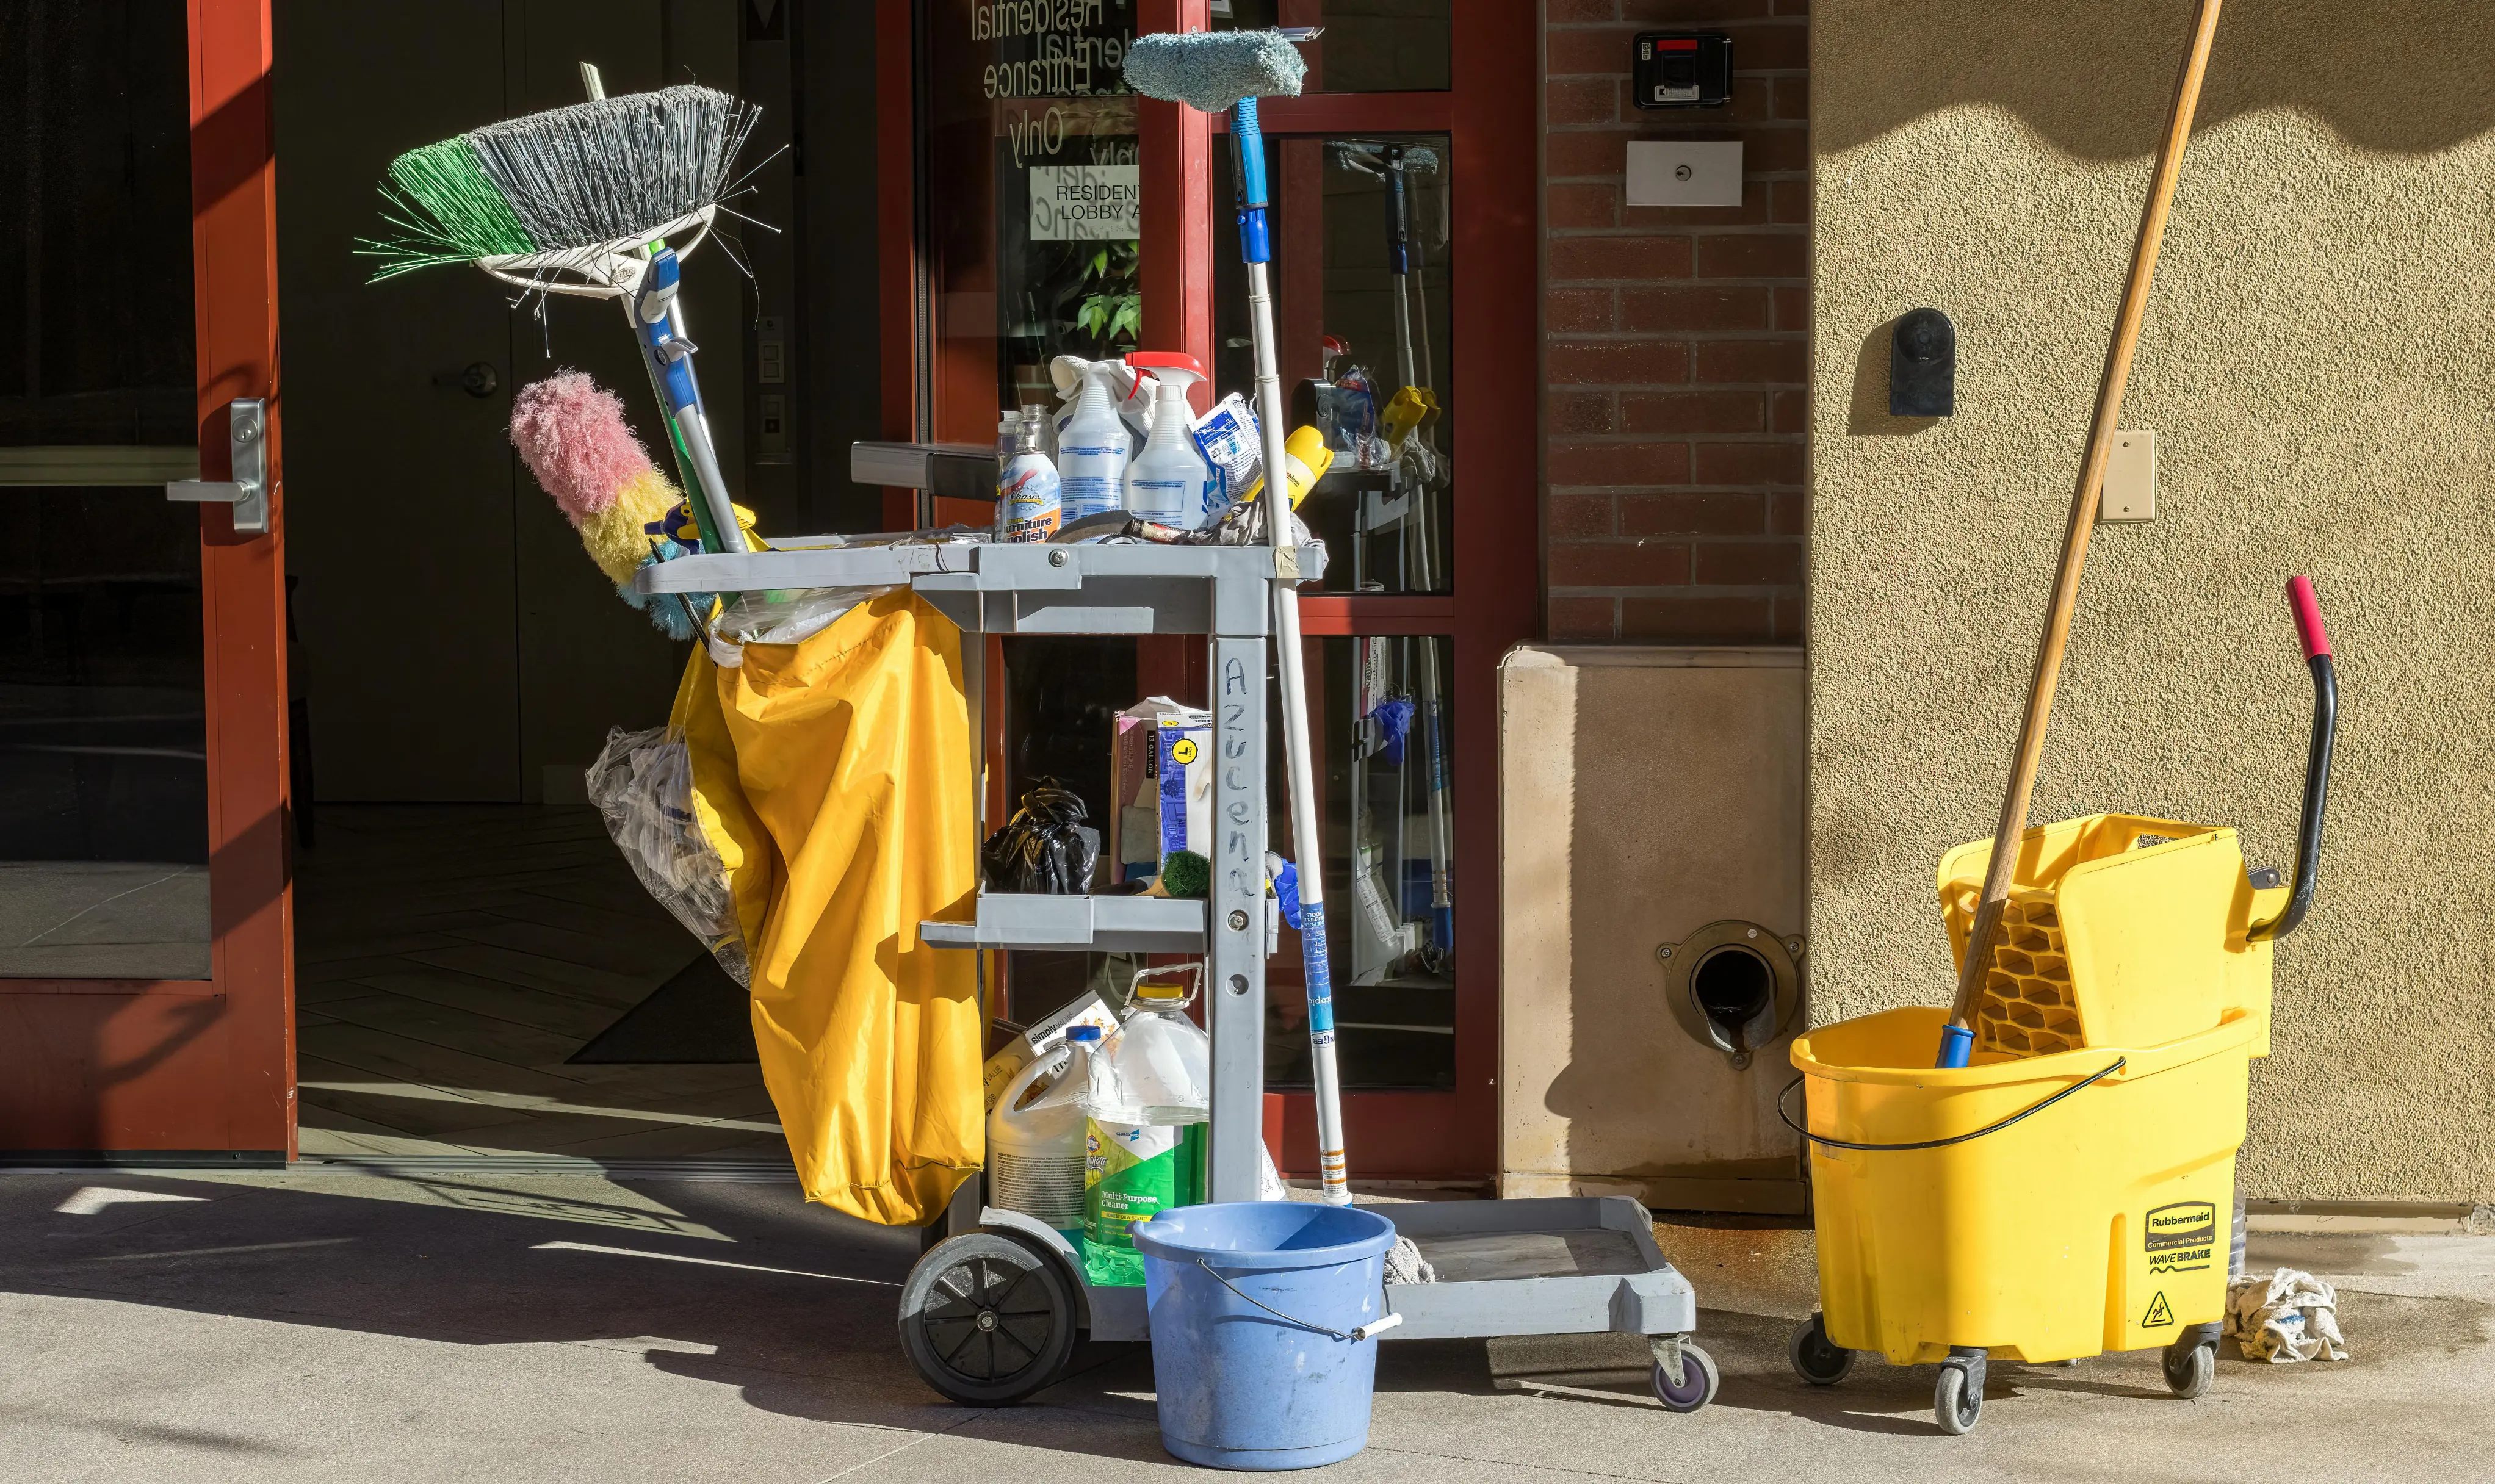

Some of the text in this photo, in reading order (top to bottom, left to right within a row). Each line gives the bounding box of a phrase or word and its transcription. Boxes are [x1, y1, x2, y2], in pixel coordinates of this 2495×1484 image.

[1056, 185, 1140, 200] RESIDEN
[1061, 204, 1124, 220] LOBBY
[1004, 517, 1053, 533] urniture
[1313, 1035, 1334, 1045] NGER
[1102, 1190, 1157, 1204] Multi-Purpose
[1102, 1199, 1129, 1209] Cleaner
[2151, 1212, 2210, 1227] Rubbermaid
[2147, 1234, 2213, 1248] Commercial Products
